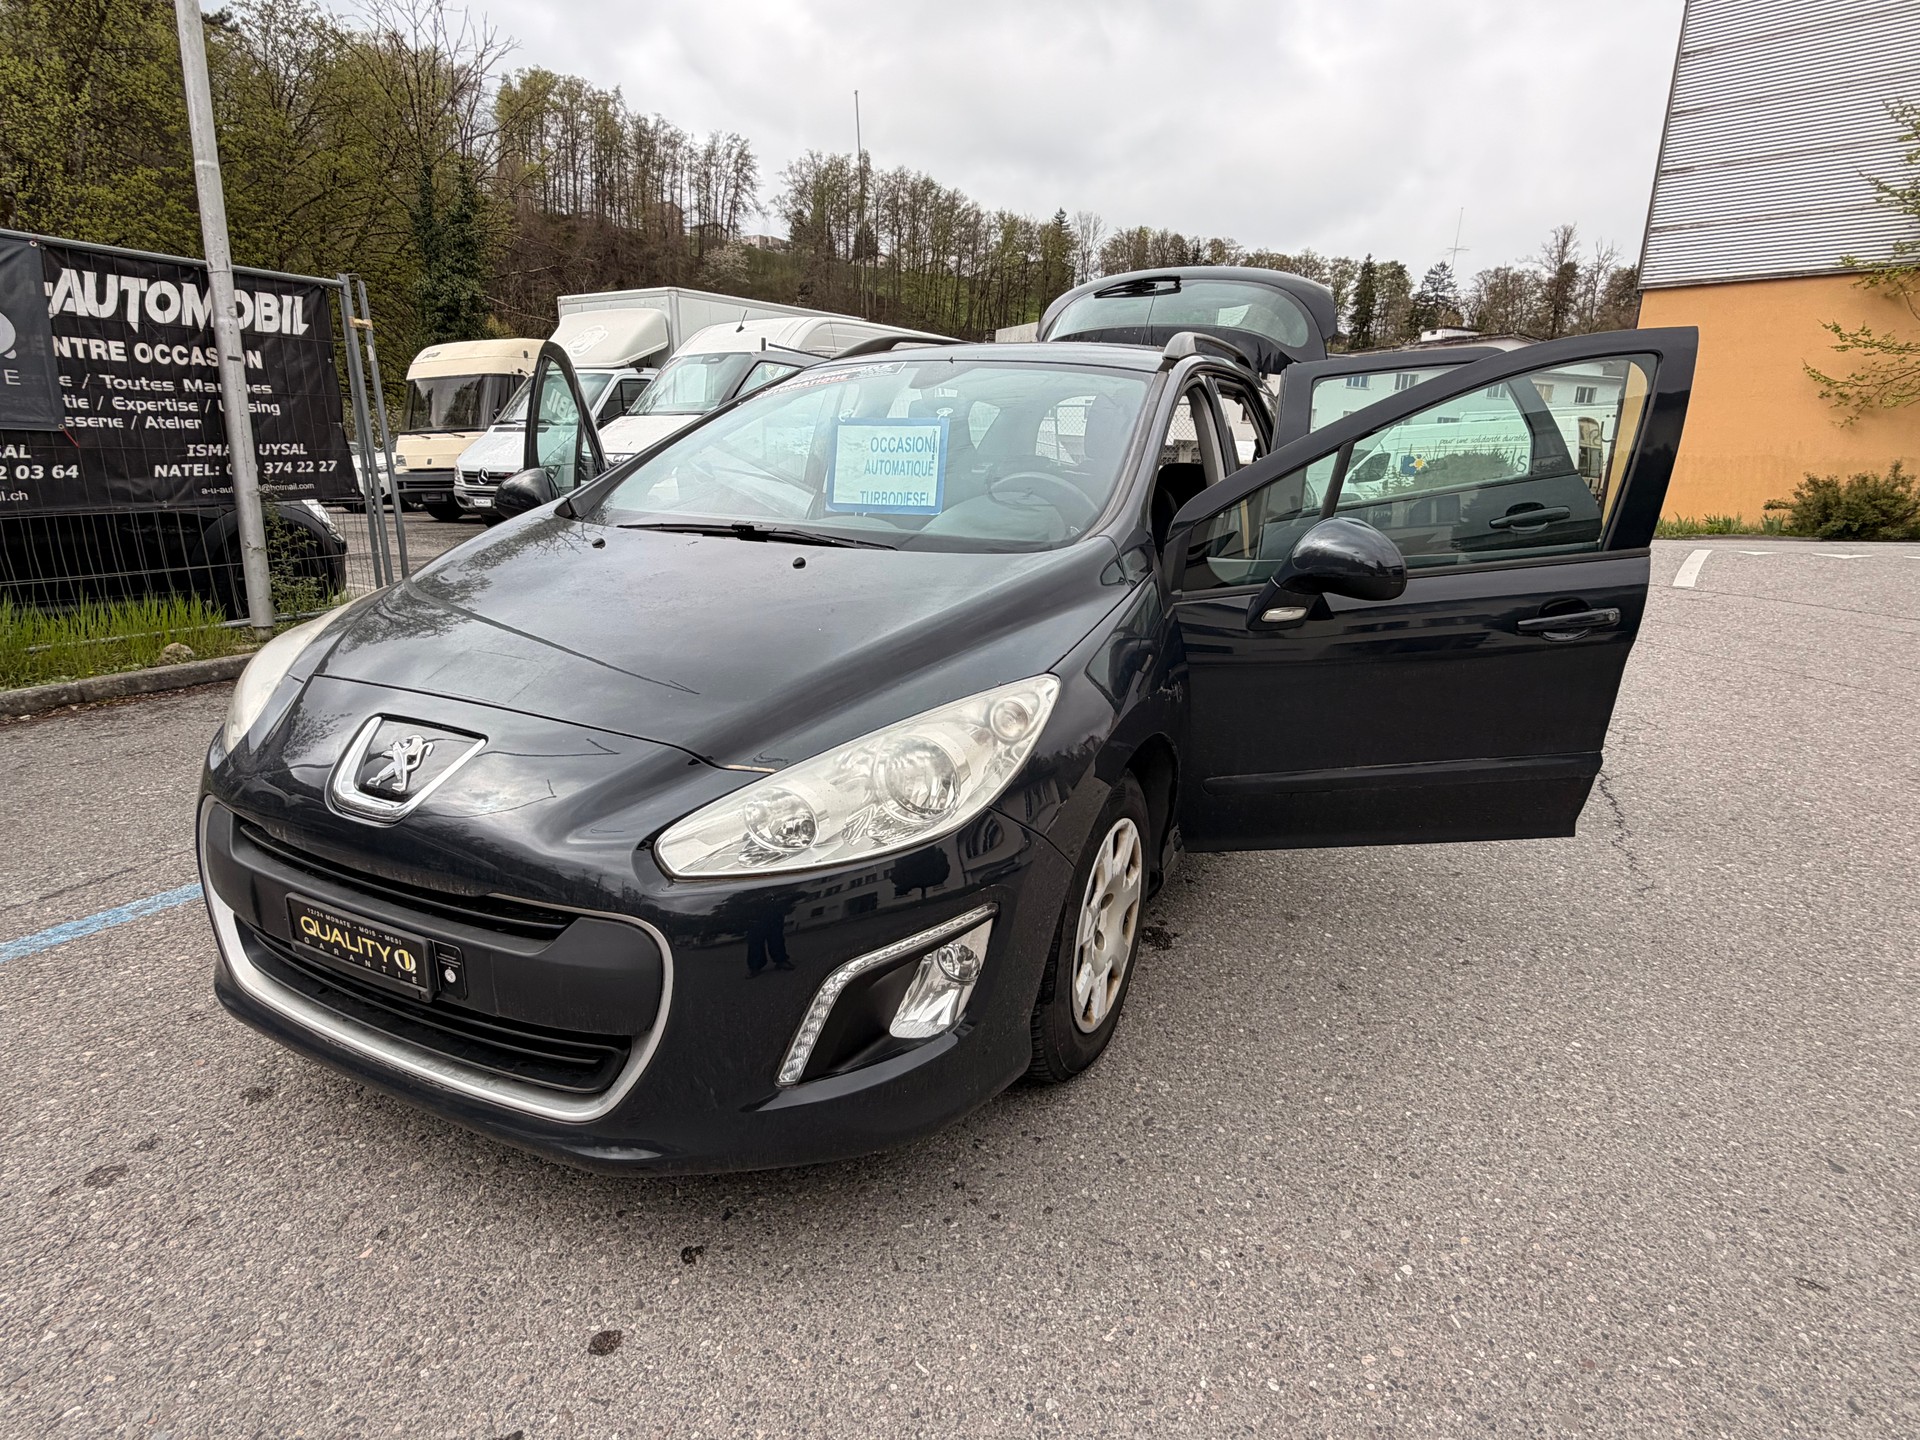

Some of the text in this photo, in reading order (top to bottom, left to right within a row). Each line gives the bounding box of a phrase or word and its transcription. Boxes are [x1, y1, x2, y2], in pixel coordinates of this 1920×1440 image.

[134, 342, 263, 370] OCCASN
[98, 374, 175, 392] Toutes
[112, 396, 199, 414] Expertise
[144, 415, 202, 429] Atelier
[0, 444, 32, 459] AL
[258, 443, 308, 455] UYSAL
[870, 437, 932, 453] OCCASION
[15, 465, 44, 479] 03
[51, 464, 79, 479] 64
[154, 463, 220, 478] NATEL:
[263, 462, 293, 474] 374
[296, 461, 315, 473] 22
[318, 460, 338, 472] 27
[863, 459, 935, 477] AUTOMATIQUE
[300, 915, 391, 963] QUALITY
[359, 926, 376, 937] MOIS
[304, 936, 418, 984] GARANTIE
